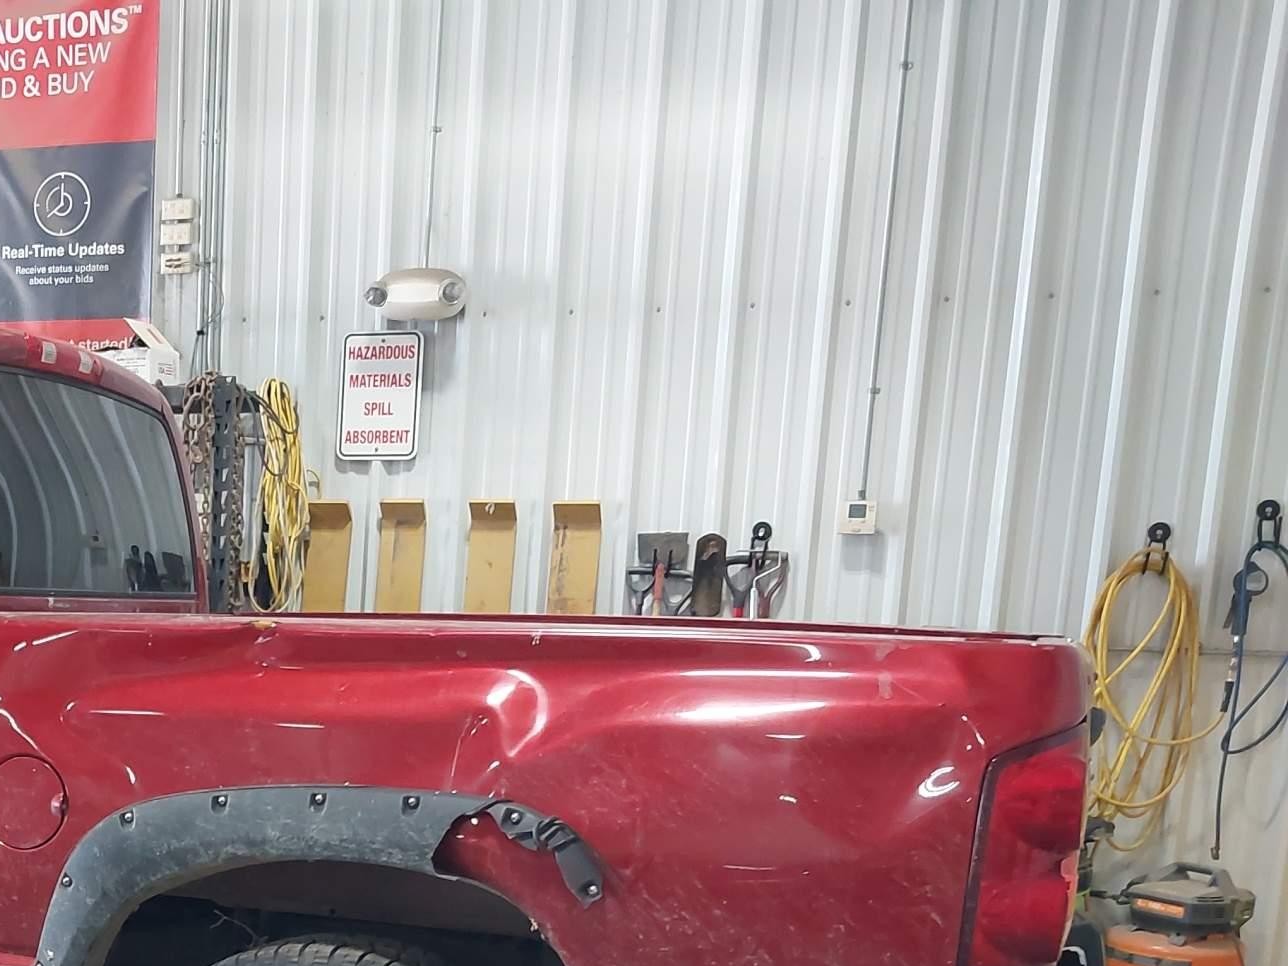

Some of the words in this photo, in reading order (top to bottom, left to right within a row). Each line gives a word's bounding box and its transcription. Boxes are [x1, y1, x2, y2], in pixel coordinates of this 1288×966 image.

[33, 46, 50, 69] A
[57, 41, 111, 67] NEW
[23, 74, 41, 98] &
[48, 70, 94, 96] BUY
[2, 244, 65, 259] Real-Time
[68, 241, 125, 258] Updates
[16, 265, 46, 274] Receive
[48, 264, 72, 273] status
[75, 263, 109, 274] updates
[29, 275, 52, 285] about
[54, 276, 73, 286] your
[75, 274, 93, 283] bids
[348, 345, 415, 361] HAZARDOUS
[349, 373, 411, 388] MATERIALS
[364, 402, 393, 416] SPILL
[344, 430, 410, 444] ABSORBENT
